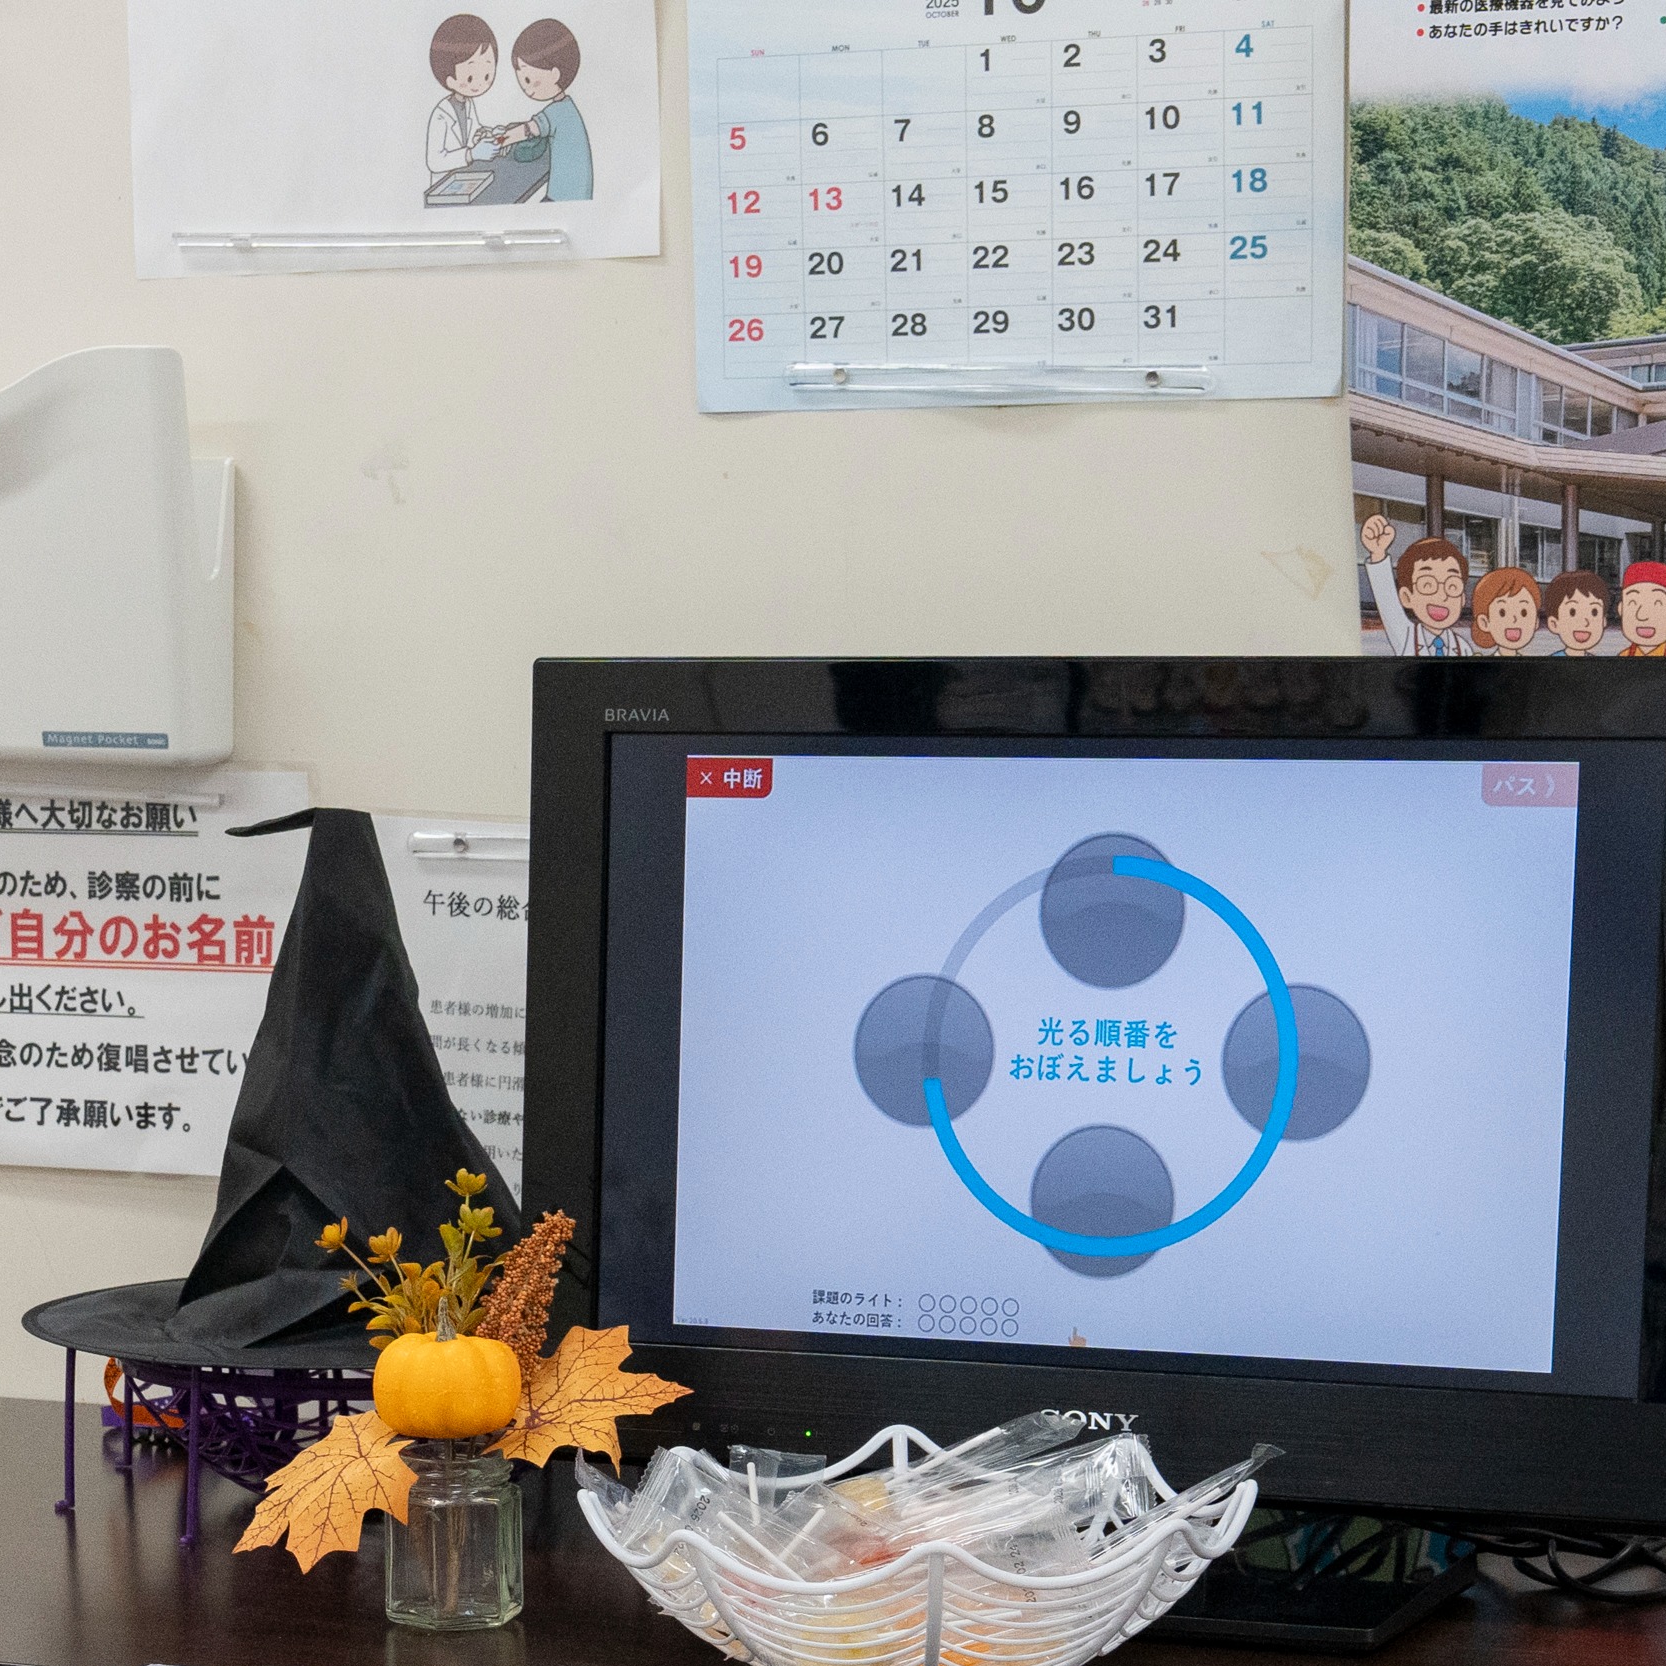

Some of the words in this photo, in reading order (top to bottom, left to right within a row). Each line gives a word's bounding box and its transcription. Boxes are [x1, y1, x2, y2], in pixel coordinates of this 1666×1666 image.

[925, 10, 960, 19] OCTOBER
[1429, 16, 1623, 39] あなたの手はきれいですか？
[751, 49, 765, 57] SUN
[831, 44, 850, 52] MON
[1000, 35, 1017, 43] WED
[1087, 30, 1101, 38] THU
[1261, 20, 1275, 28] SAT
[980, 49, 991, 72] 1
[1063, 44, 1081, 67] 2
[1149, 39, 1166, 63] 3
[1235, 34, 1254, 57] 4
[729, 127, 746, 150] 5
[812, 123, 829, 146] 6
[894, 119, 911, 142] 7
[977, 114, 995, 137] 8
[1063, 110, 1081, 134] 9
[1145, 105, 1180, 129] 10
[1232, 101, 1263, 125] 11
[727, 190, 761, 216] 12
[808, 186, 843, 212] 13
[891, 183, 925, 209] 14
[973, 179, 1008, 204] 15
[1059, 176, 1095, 201] 16
[1145, 172, 1180, 196] 17
[1232, 168, 1267, 192] 18
[728, 254, 762, 279] 19
[808, 251, 844, 276] 20
[890, 248, 924, 273] 21
[972, 244, 1009, 270] 22
[1057, 241, 1096, 267] 23
[1143, 238, 1180, 264] 24
[1228, 235, 1268, 260] 25
[727, 318, 764, 343] 26
[809, 315, 845, 340] 27
[891, 312, 928, 338] 28
[972, 309, 1009, 335] 29
[1057, 306, 1096, 332] 30
[1143, 305, 1179, 329] 31
[605, 708, 669, 721] BRAVIA
[47, 734, 92, 746] Magnet
[98, 735, 139, 745] Pocket
[723, 769, 762, 788] 中断
[1493, 775, 1535, 796] パス
[1037, 1015, 1179, 1050] 光る順番を
[1009, 1050, 1205, 1089] おぼえましょう
